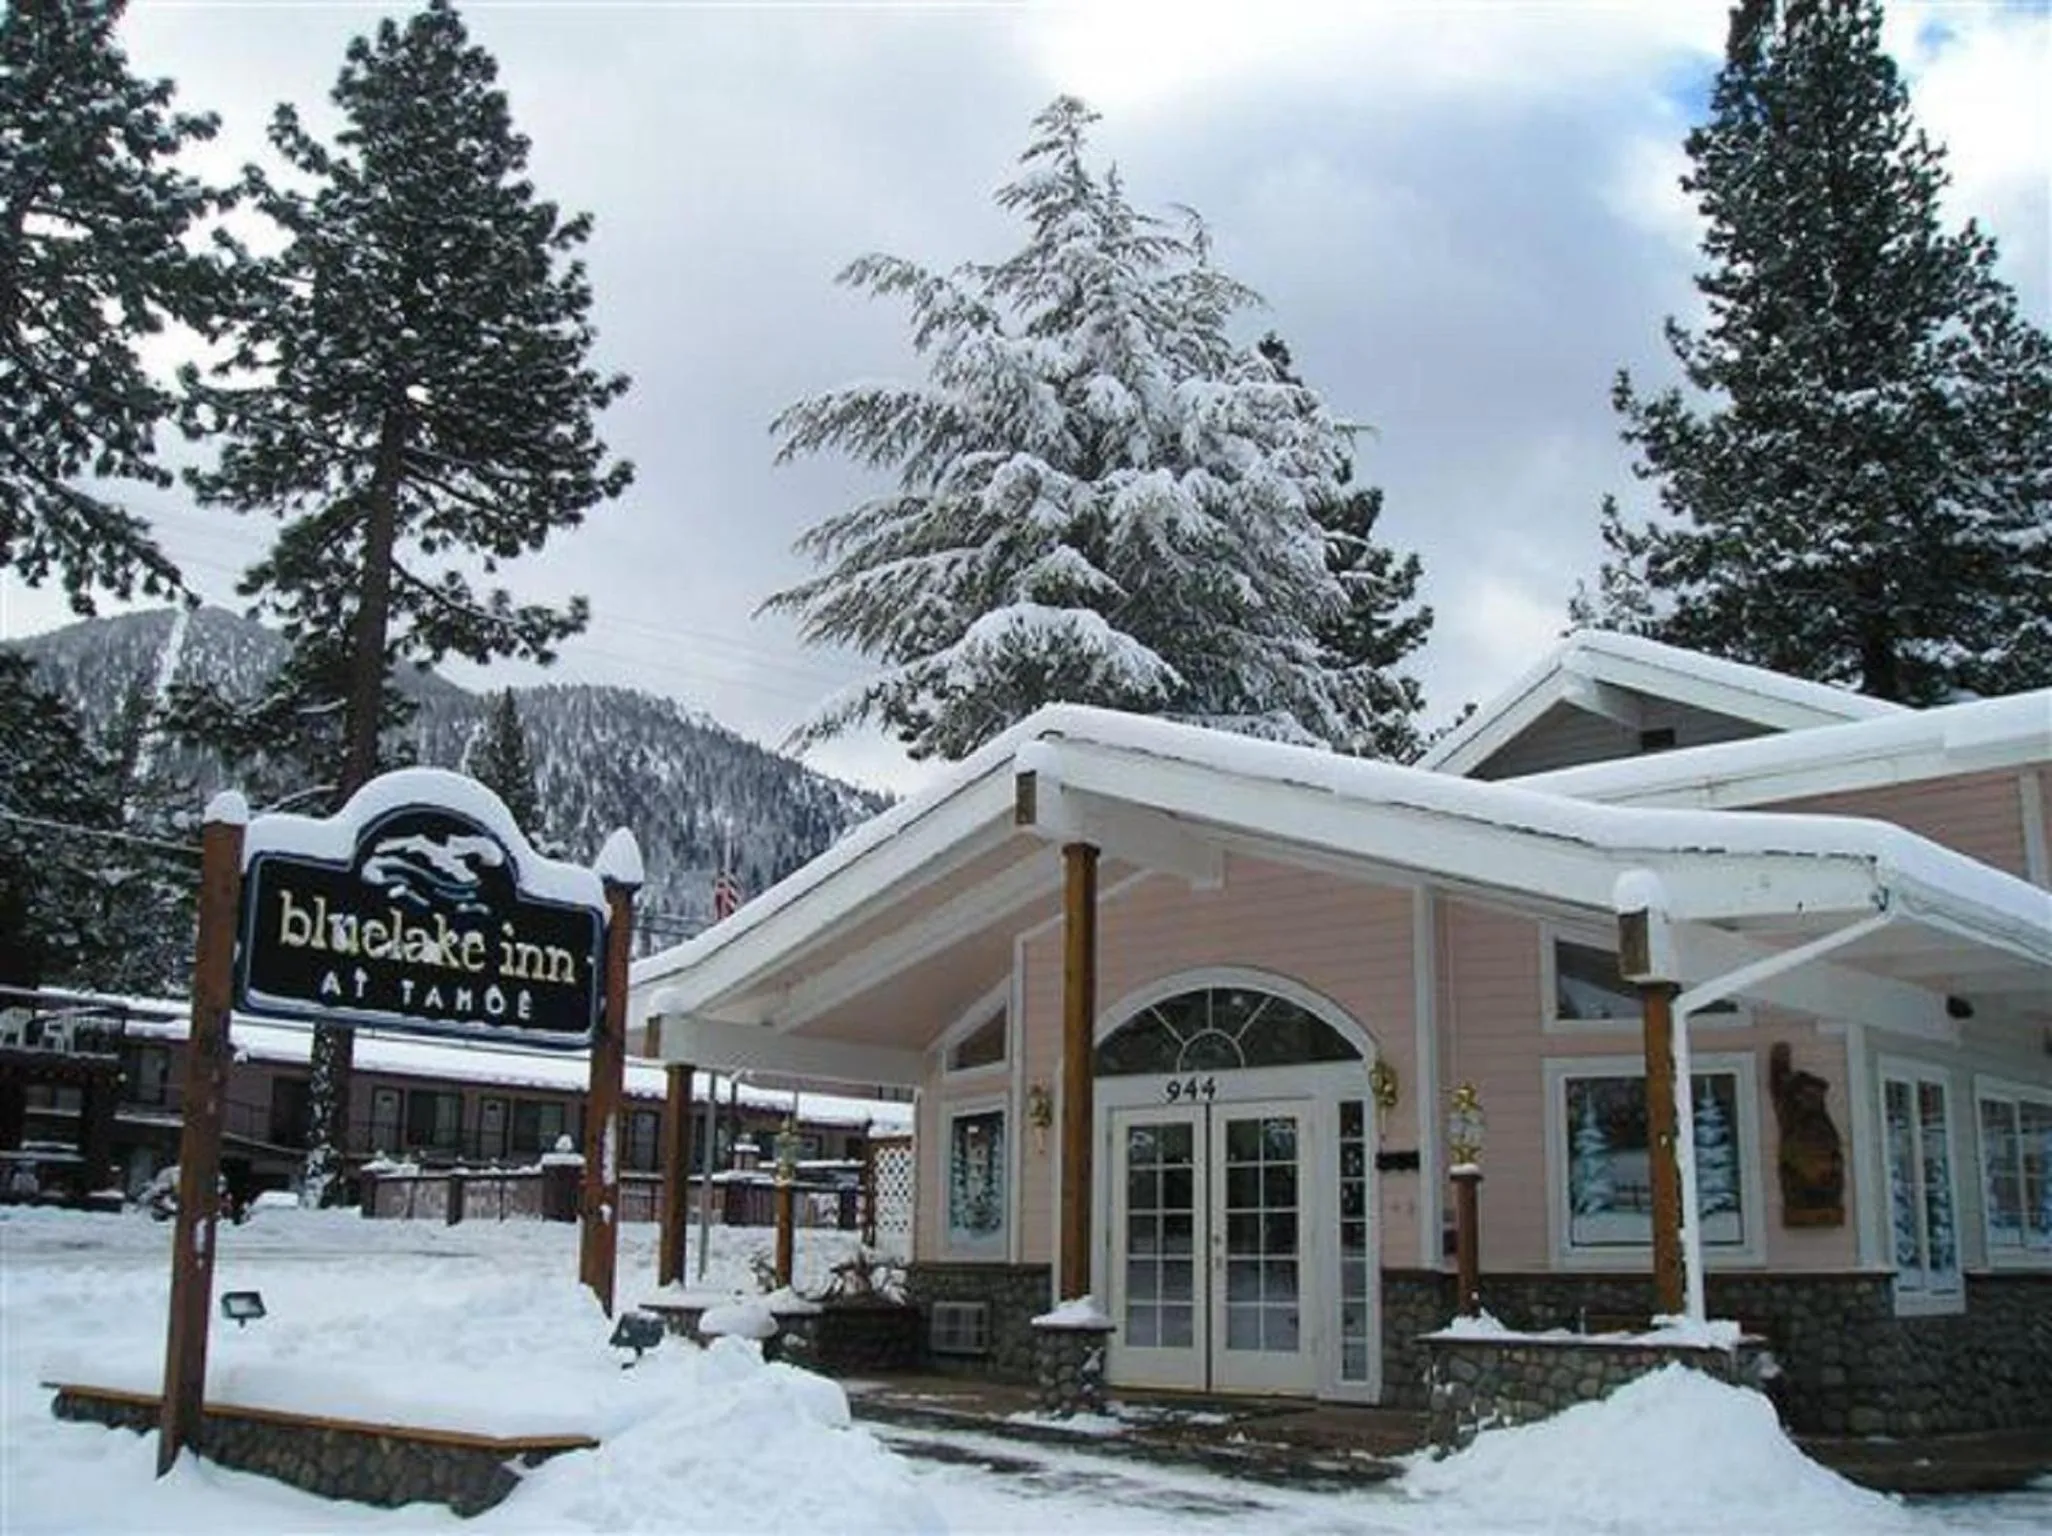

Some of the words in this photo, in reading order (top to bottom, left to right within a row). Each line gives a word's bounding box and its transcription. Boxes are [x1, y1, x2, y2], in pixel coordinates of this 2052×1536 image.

[279, 891, 486, 971] bluelake
[500, 923, 576, 984] inn
[320, 968, 369, 999] AT
[402, 979, 532, 1020] TAHOE
[1165, 1077, 1216, 1104] 944
